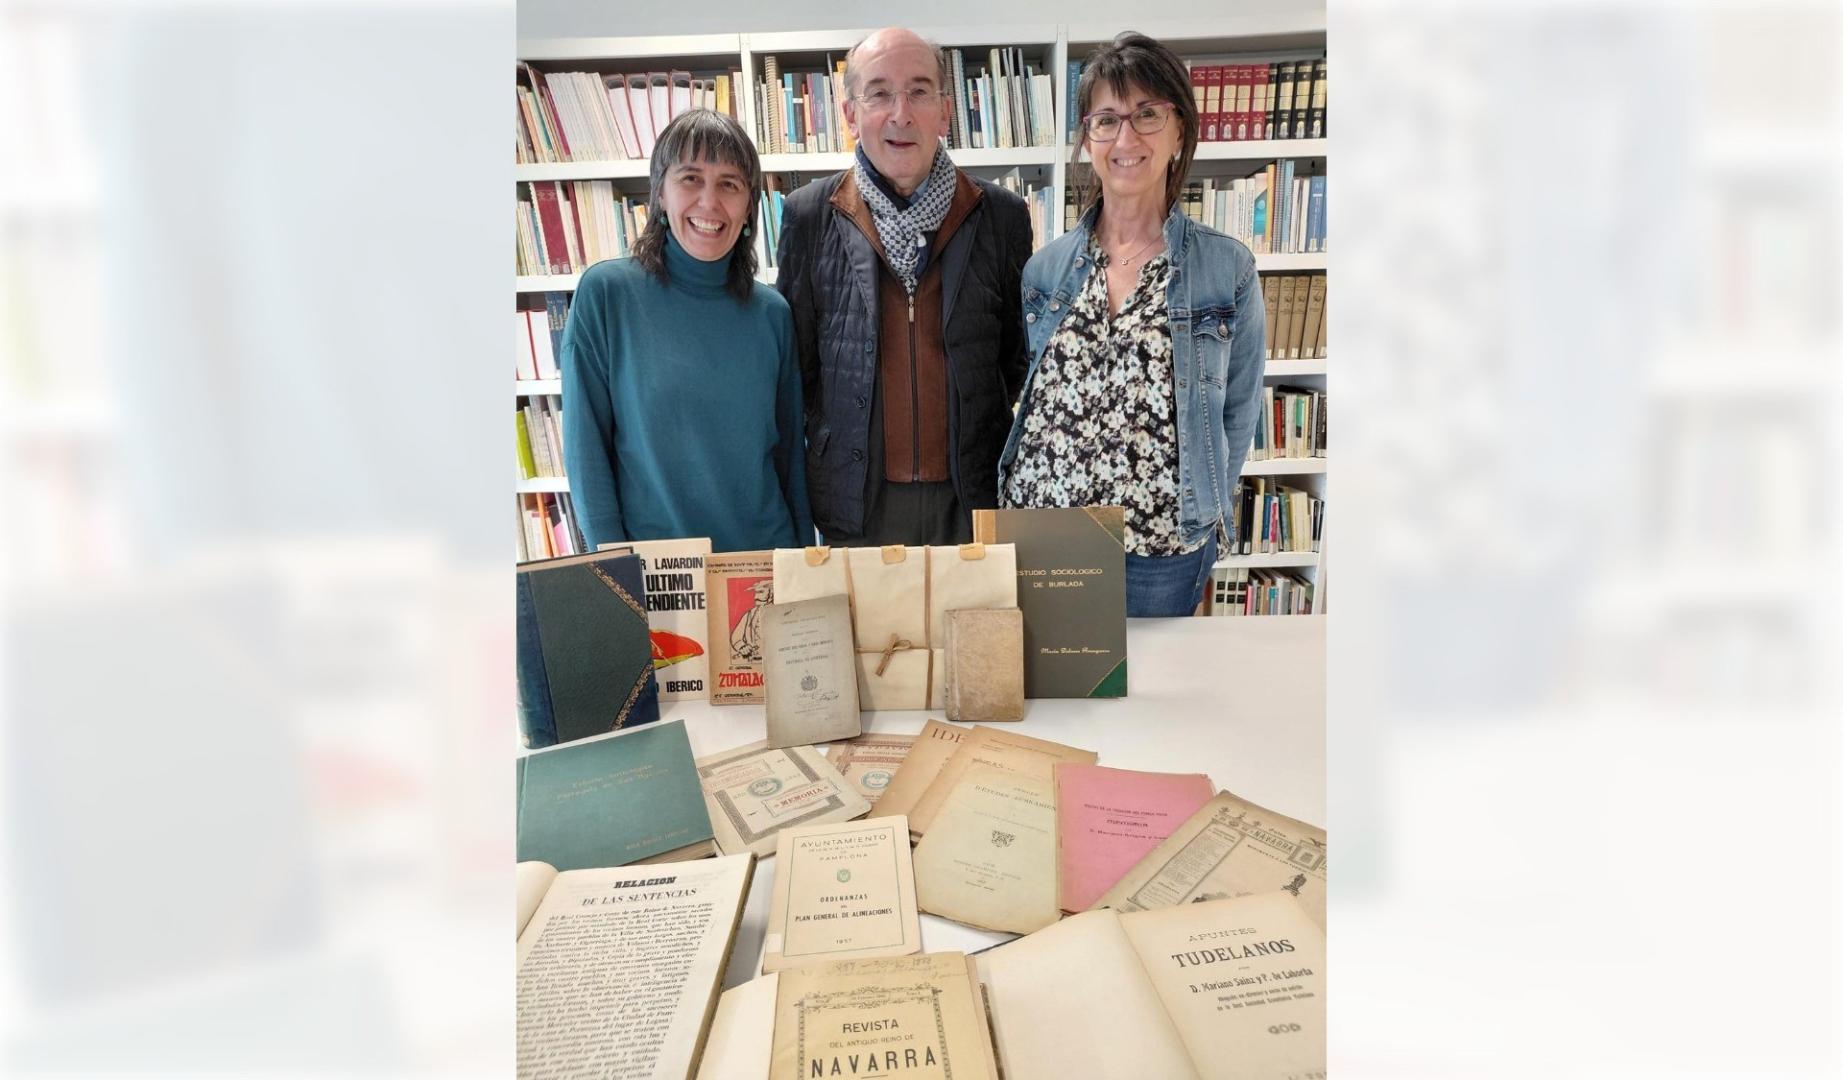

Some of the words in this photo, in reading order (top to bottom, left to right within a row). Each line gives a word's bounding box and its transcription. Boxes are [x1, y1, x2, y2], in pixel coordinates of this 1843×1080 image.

[654, 556, 703, 570] LAVARDIN
[1051, 568, 1103, 576] SOCIOLOGICO
[646, 573, 693, 592] ULTIMO
[666, 680, 703, 692] IBERICO
[780, 788, 823, 807] MEMORIA
[801, 834, 886, 848] AYUNTAMIENTO
[1253, 830, 1295, 854] NAVARRA
[613, 876, 677, 889] RELACION
[582, 897, 598, 906] DE
[601, 896, 624, 905] LAS
[626, 888, 697, 902] SENTENCIAS
[820, 893, 868, 903] ORDENANZAS
[814, 912, 838, 920] GENERAL
[852, 908, 893, 917] ALINEACIONES
[1188, 928, 1257, 942] APUNTES
[1172, 939, 1296, 969] TUDELANOS
[1189, 984, 1201, 993] D.
[1201, 981, 1234, 992] Mariano
[842, 1018, 899, 1034] REVISTA
[847, 1038, 878, 1048] ANTIGUO
[880, 1035, 901, 1044] REINO
[811, 1046, 937, 1078] NAVARRA
